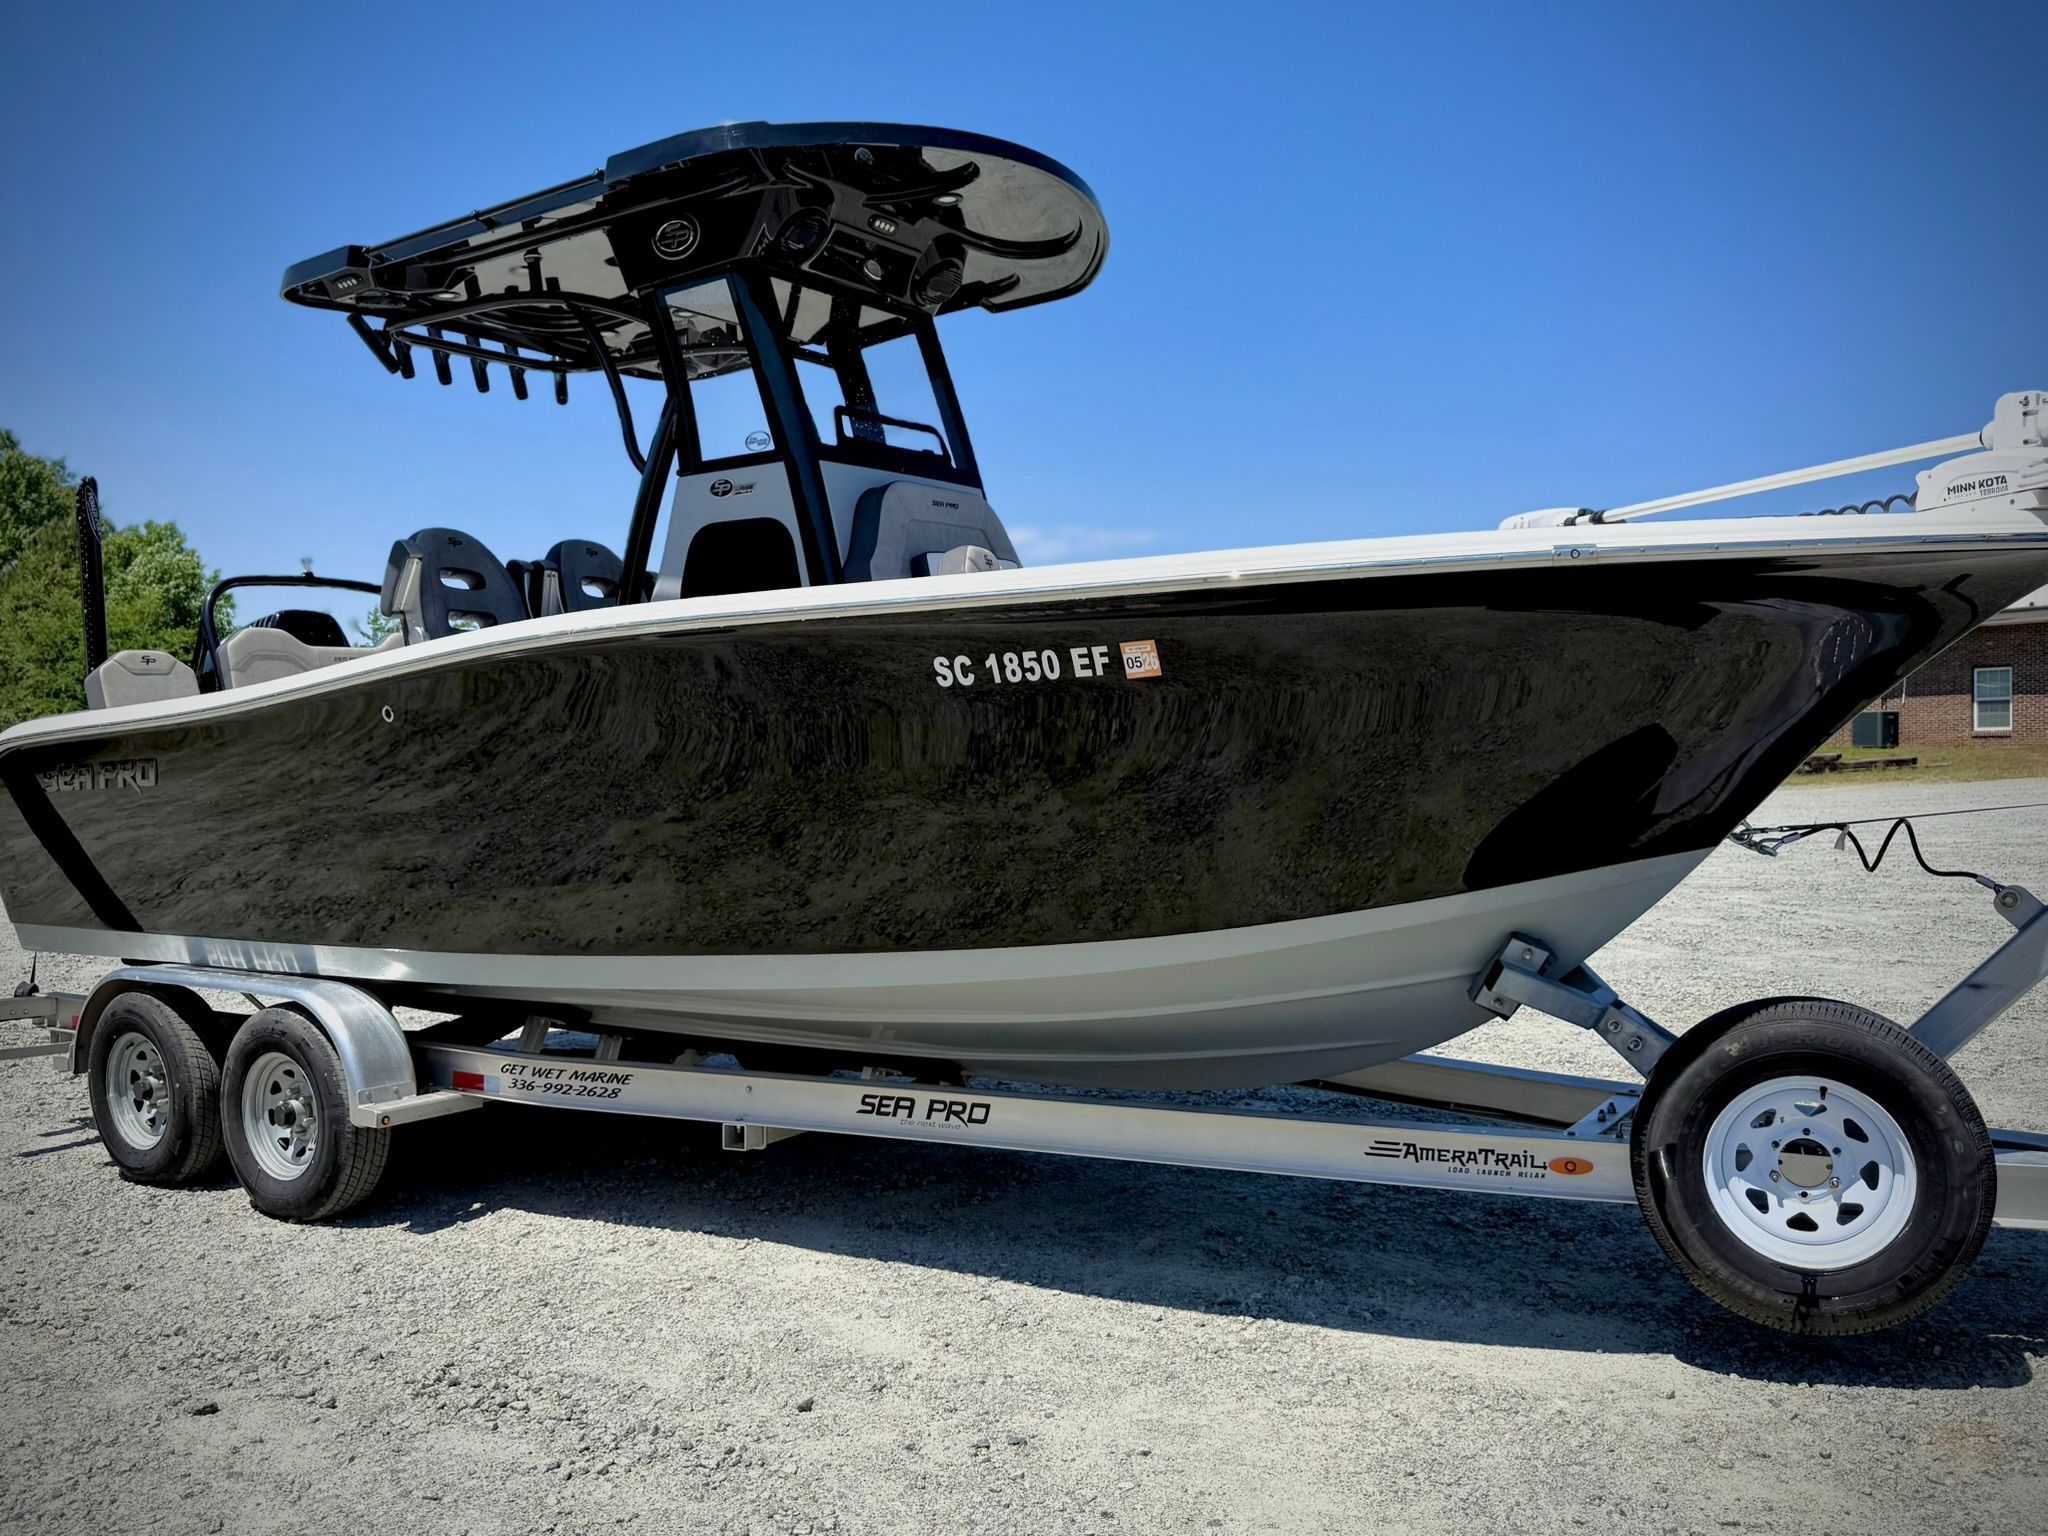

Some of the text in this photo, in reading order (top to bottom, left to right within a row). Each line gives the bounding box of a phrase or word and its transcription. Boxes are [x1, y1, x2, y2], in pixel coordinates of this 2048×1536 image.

[1947, 481, 1976, 495] MINN
[1978, 475, 2008, 489] KOTA
[933, 645, 1110, 688] SC 1850 EF
[1126, 656, 1143, 670] 05
[42, 758, 159, 797] SEA PRO
[501, 1063, 634, 1086] GET WET MARINE
[508, 1078, 622, 1099] 336-992-2628
[856, 1094, 991, 1128] SEA PRO
[900, 1118, 962, 1131] the next wave
[1448, 1166, 1546, 1179] LOAD LAUNCH RELAX
